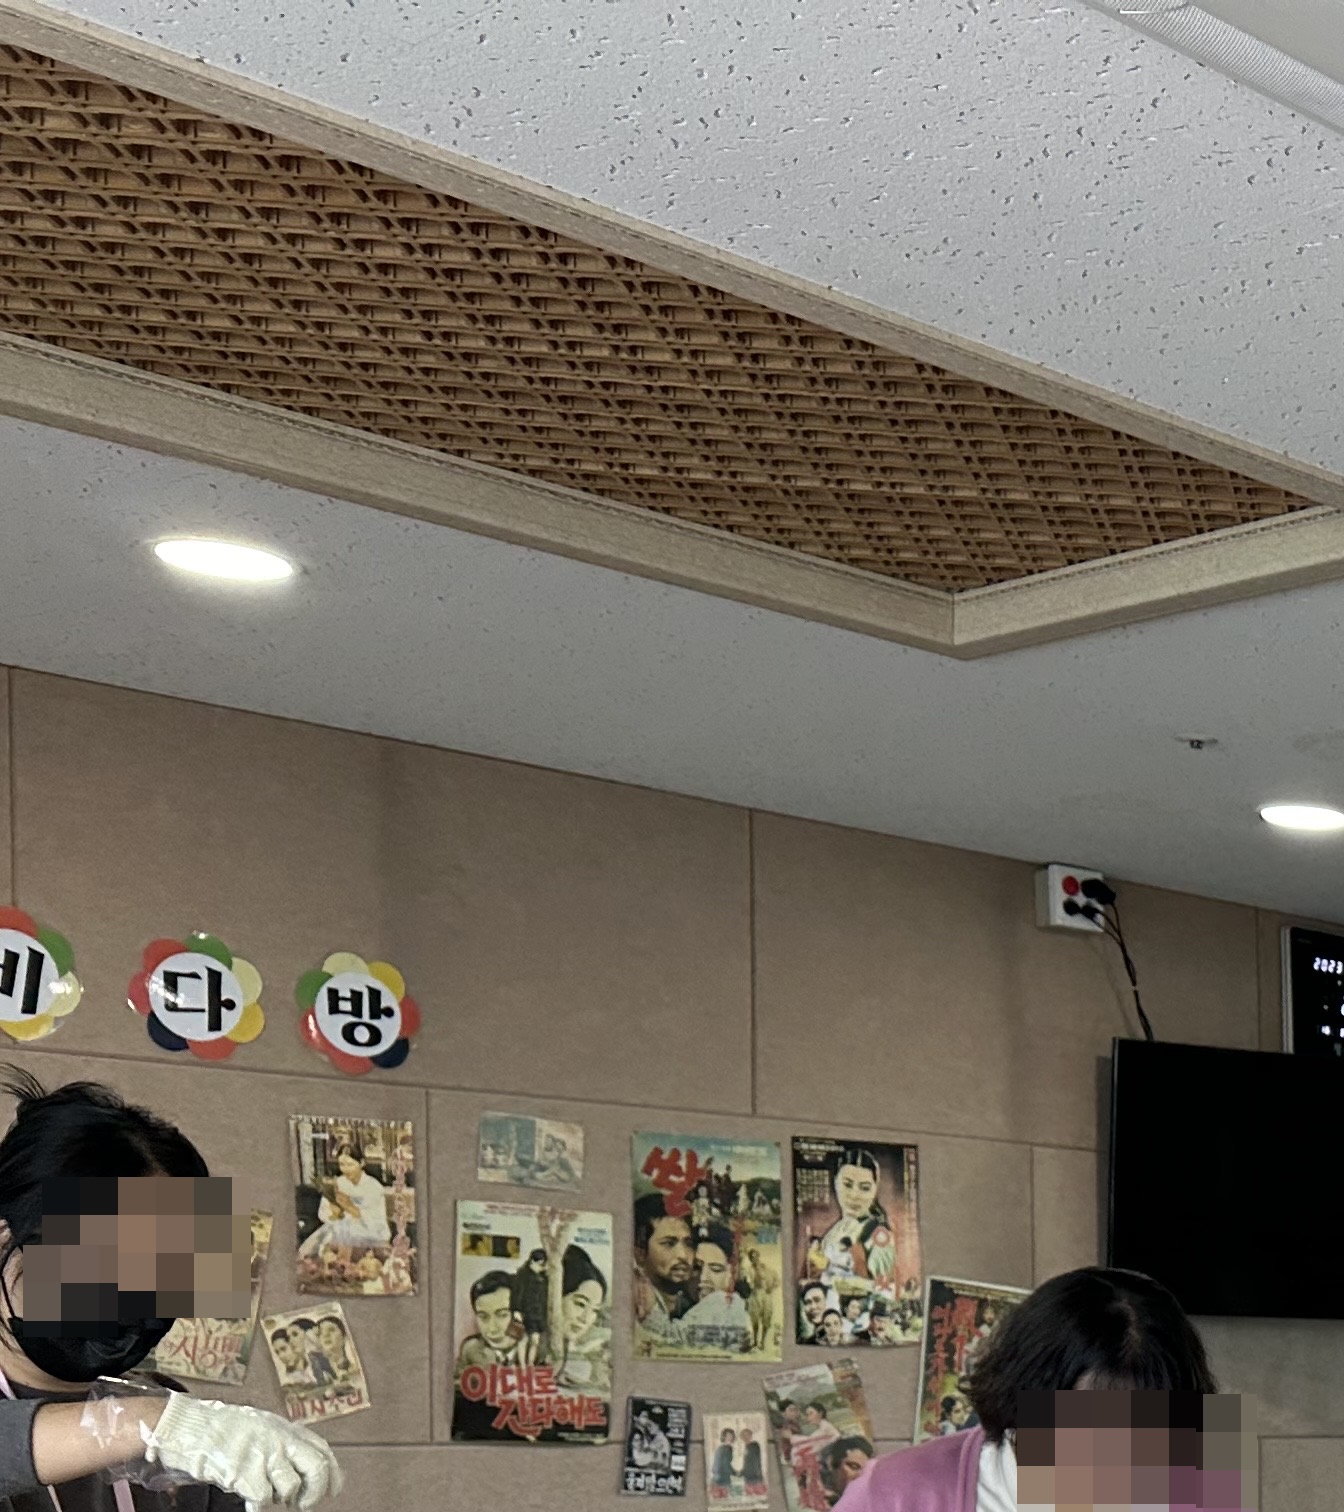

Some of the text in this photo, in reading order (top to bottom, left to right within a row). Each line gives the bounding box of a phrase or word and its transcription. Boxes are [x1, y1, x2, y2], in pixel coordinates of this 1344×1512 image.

[641, 1145, 707, 1218] 쌀
[459, 1363, 560, 1407] 이대로
[490, 1391, 608, 1437] 간다해도
